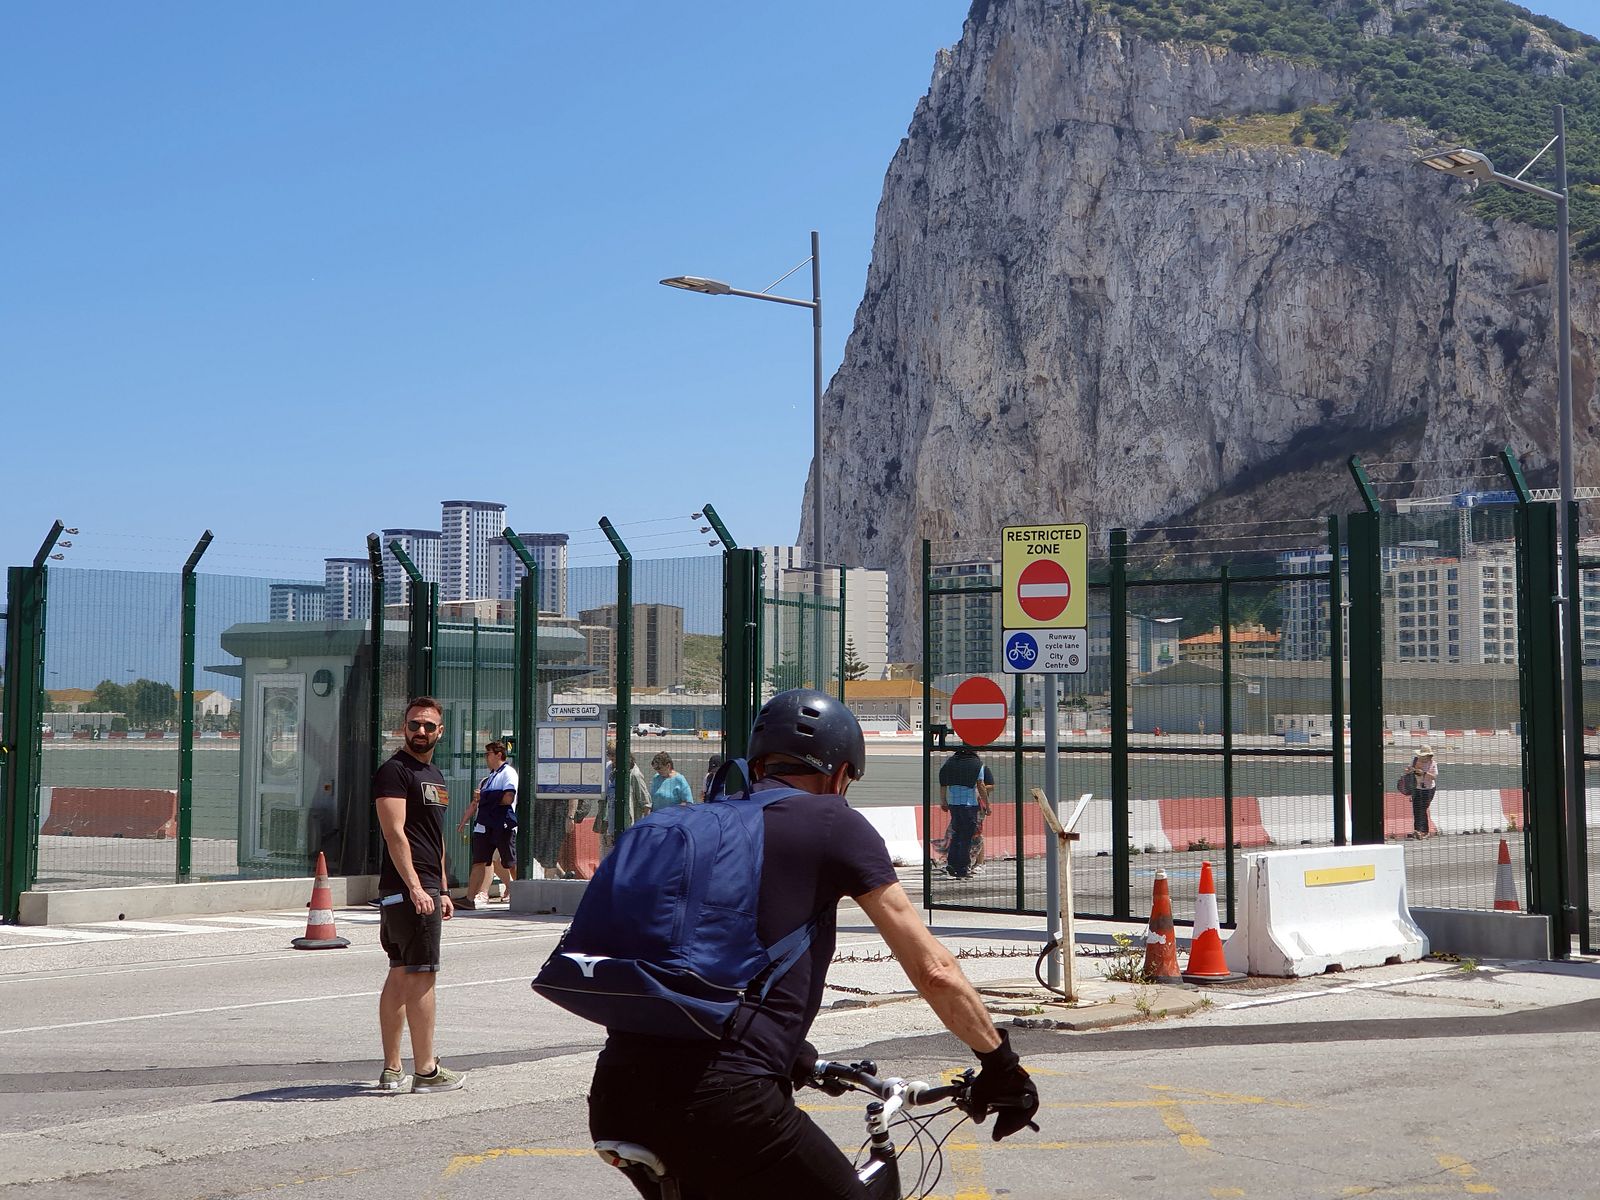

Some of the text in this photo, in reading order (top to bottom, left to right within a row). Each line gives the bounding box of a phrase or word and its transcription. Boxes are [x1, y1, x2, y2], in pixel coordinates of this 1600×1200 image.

[1007, 530, 1082, 541] RESTRICTED
[1027, 544, 1060, 554] ZONE
[1048, 633, 1077, 641] Runway
[1045, 642, 1080, 651] cycle lane
[1049, 652, 1064, 661] City
[93, 729, 99, 739] 2
